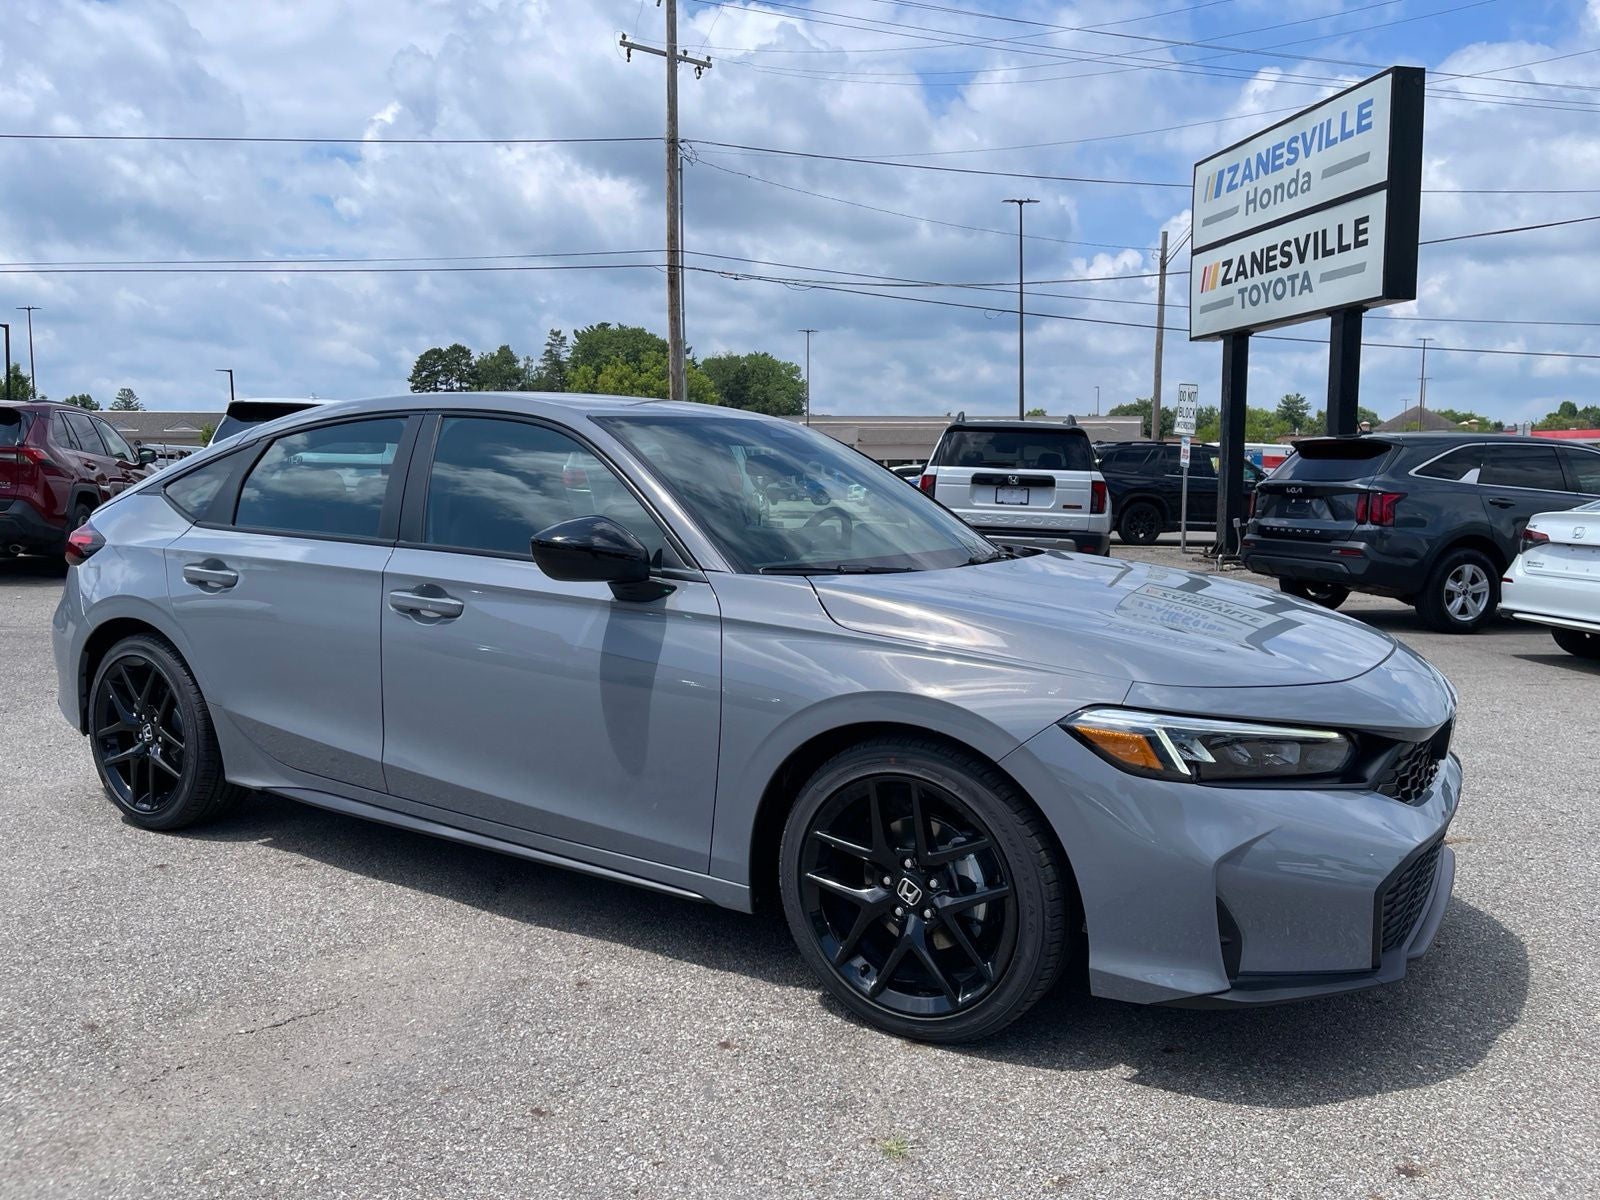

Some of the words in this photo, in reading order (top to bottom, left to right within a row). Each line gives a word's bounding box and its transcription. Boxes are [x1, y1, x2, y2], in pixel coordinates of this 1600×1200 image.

[1226, 97, 1374, 194] ZANESVILLE
[1245, 168, 1312, 216] Honda
[1221, 214, 1370, 287] ZANESVILLE
[1238, 270, 1313, 310] TOYOTA
[1178, 406, 1195, 418] BLOCK
[1179, 390, 1186, 402] DO
[1188, 391, 1197, 403] NOT
[963, 513, 1079, 527] ASSPORT
